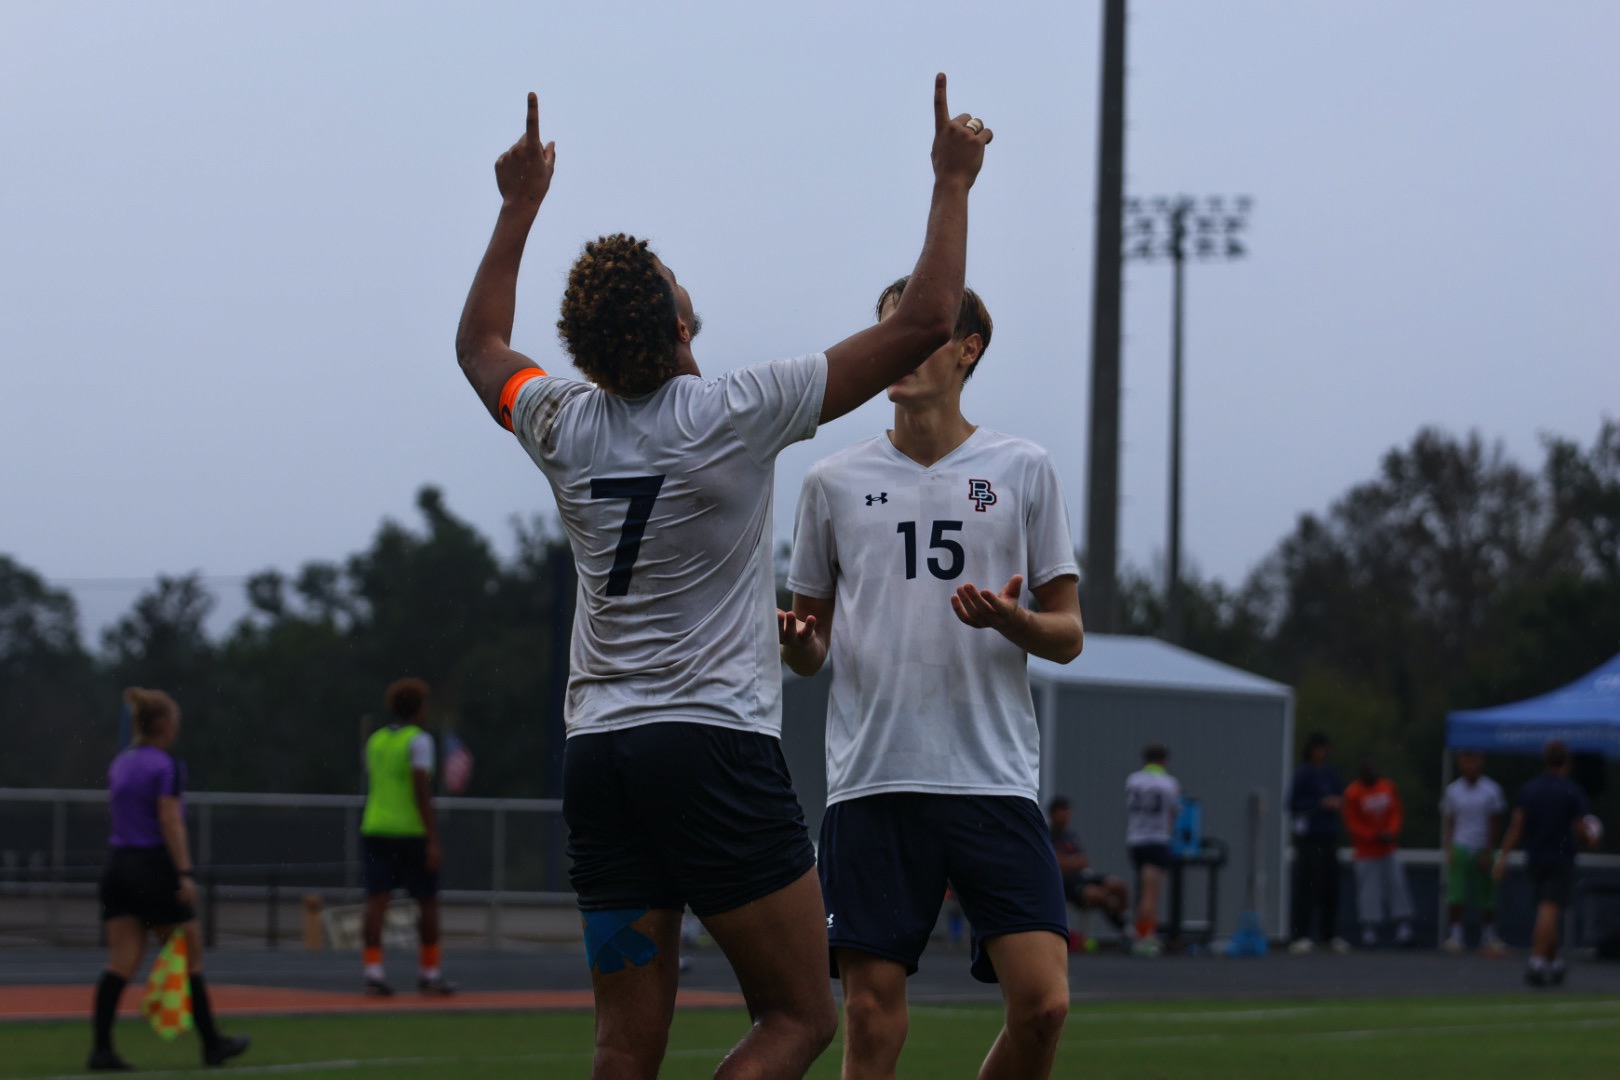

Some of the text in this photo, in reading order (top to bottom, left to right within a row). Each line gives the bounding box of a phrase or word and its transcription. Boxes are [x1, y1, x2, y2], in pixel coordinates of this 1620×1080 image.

[968, 479, 997, 512] BP
[590, 474, 666, 597] 7
[896, 520, 965, 580] 15
